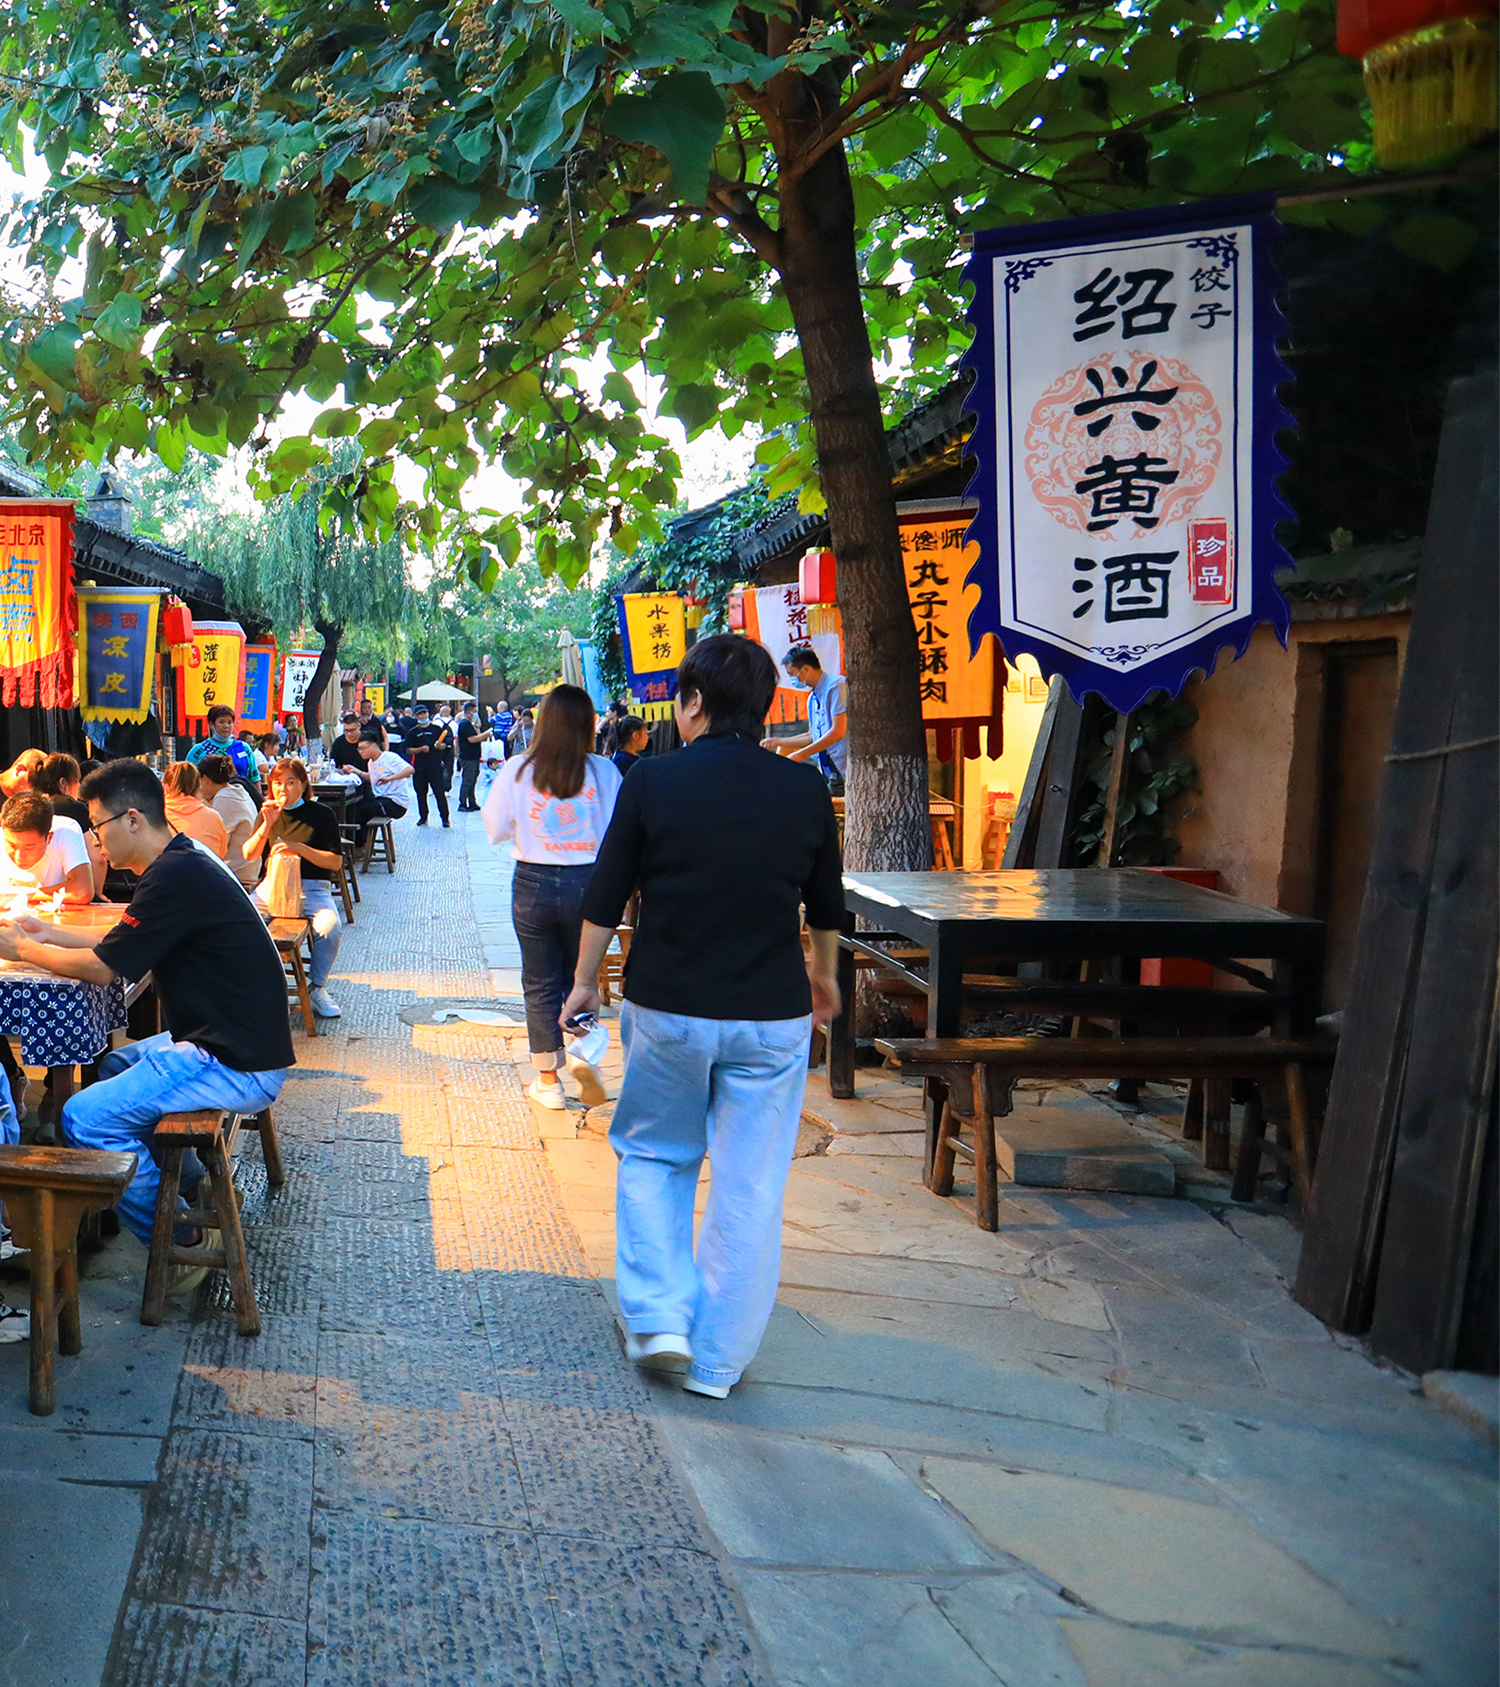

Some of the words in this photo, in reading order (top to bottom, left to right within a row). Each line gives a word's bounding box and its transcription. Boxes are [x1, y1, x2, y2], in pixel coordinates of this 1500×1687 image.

[1189, 264, 1233, 330] 饺子
[1072, 267, 1180, 624] 绍兴黄酒
[1196, 536, 1228, 588] 珍品
[92, 612, 139, 629] 陕西
[646, 604, 672, 658] 水果捞
[783, 588, 812, 648] 桂花山
[909, 559, 949, 703] 丸子小酥肉
[100, 635, 131, 693] 凉皮
[203, 643, 220, 707] 灌汤包
